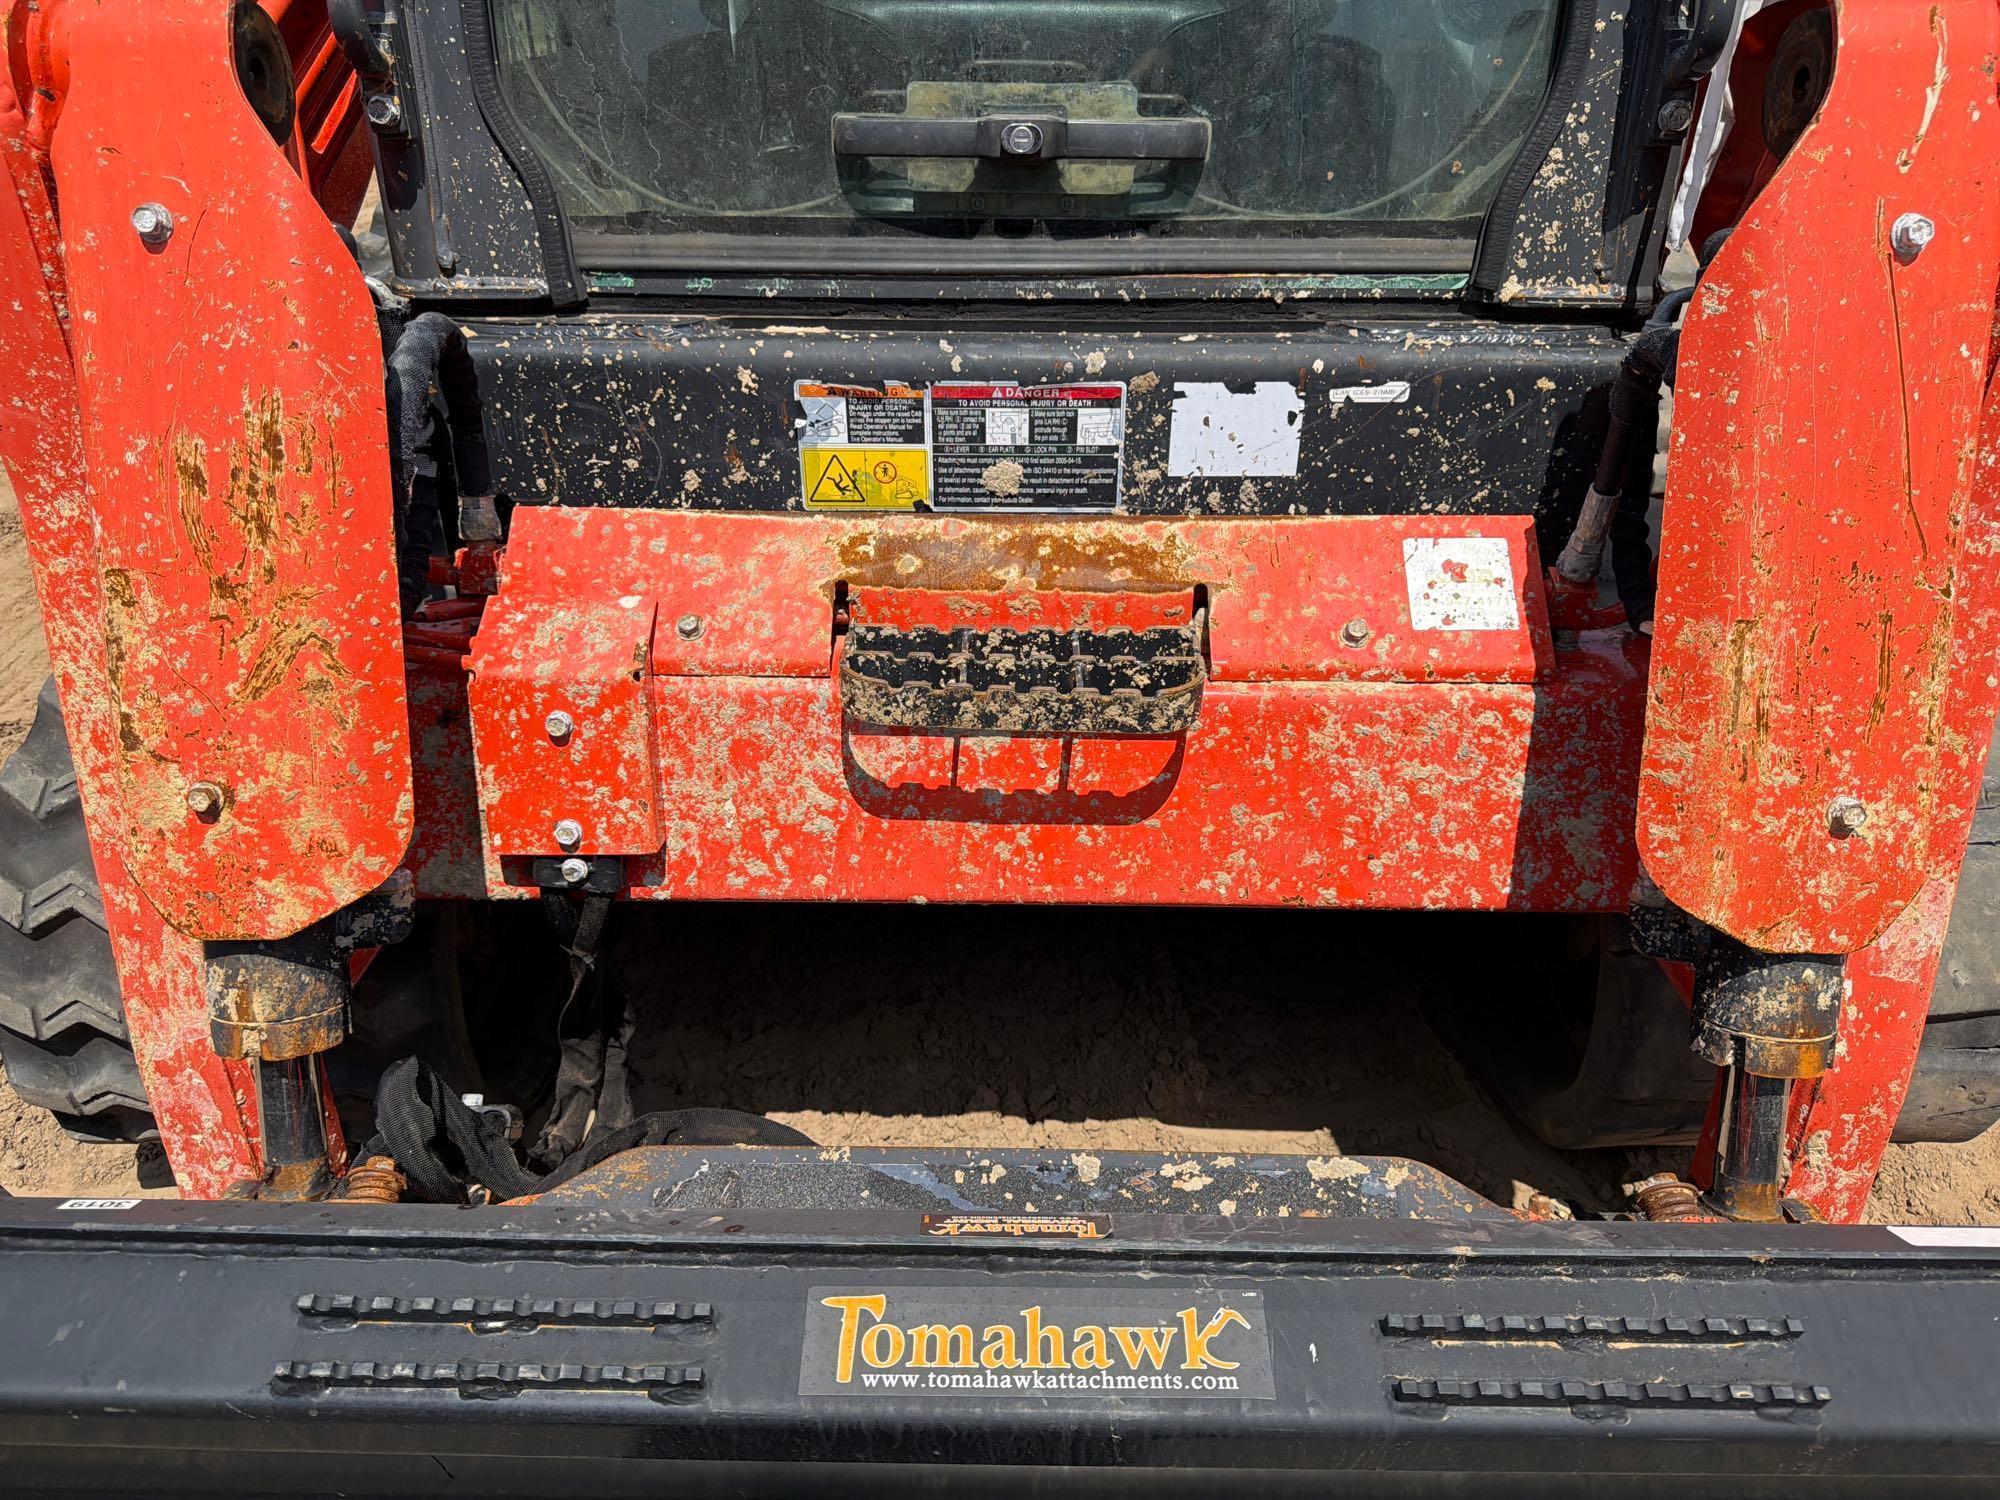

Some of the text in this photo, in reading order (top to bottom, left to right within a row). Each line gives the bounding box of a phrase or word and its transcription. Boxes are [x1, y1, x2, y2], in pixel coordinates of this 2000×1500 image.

[1006, 388, 1059, 397] DANGER
[928, 1222, 1106, 1239] Tomahawk
[821, 1294, 1252, 1383] Tomahawk
[861, 1369, 1240, 1390] www.tomahawkattachments.com
